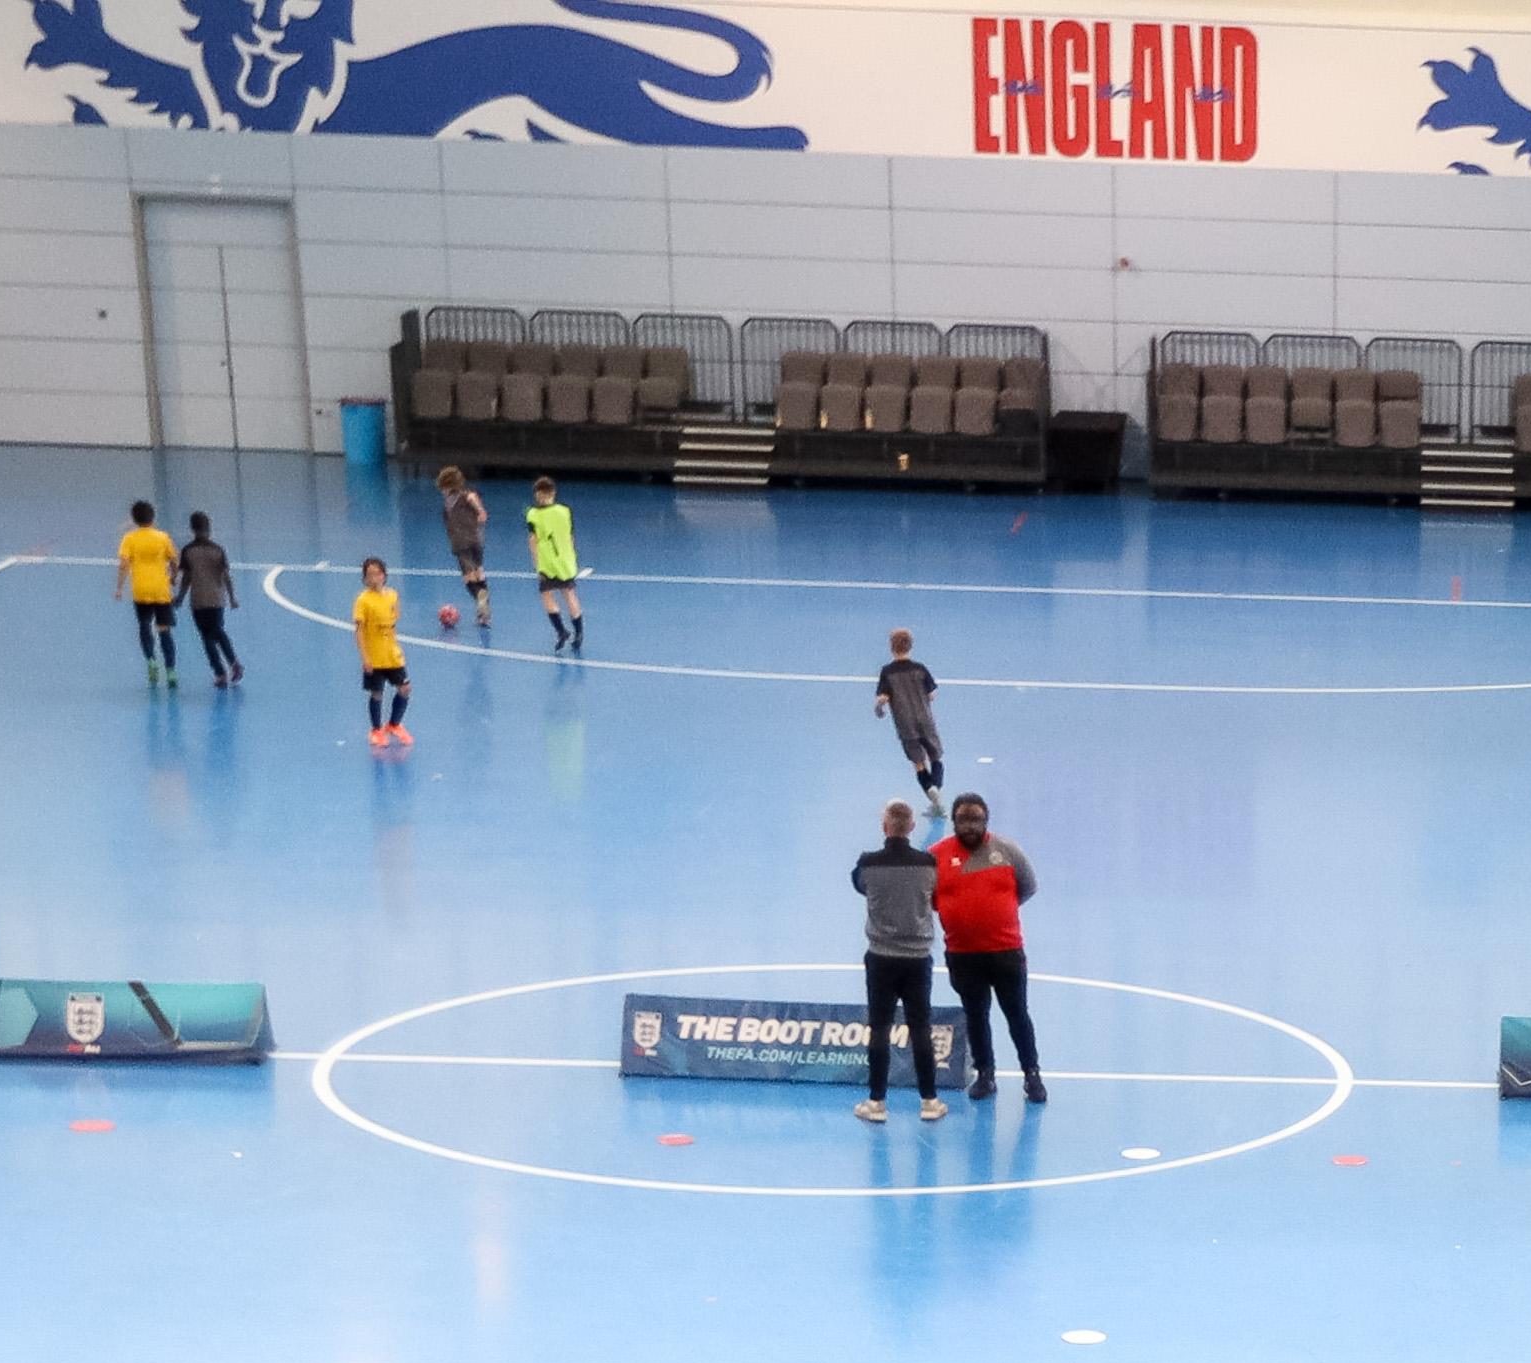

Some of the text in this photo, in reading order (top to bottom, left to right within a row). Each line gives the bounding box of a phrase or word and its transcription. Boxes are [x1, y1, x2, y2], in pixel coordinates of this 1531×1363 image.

[972, 17, 1259, 163] ENGLAND
[677, 1014, 909, 1049] THE BOOT ROM
